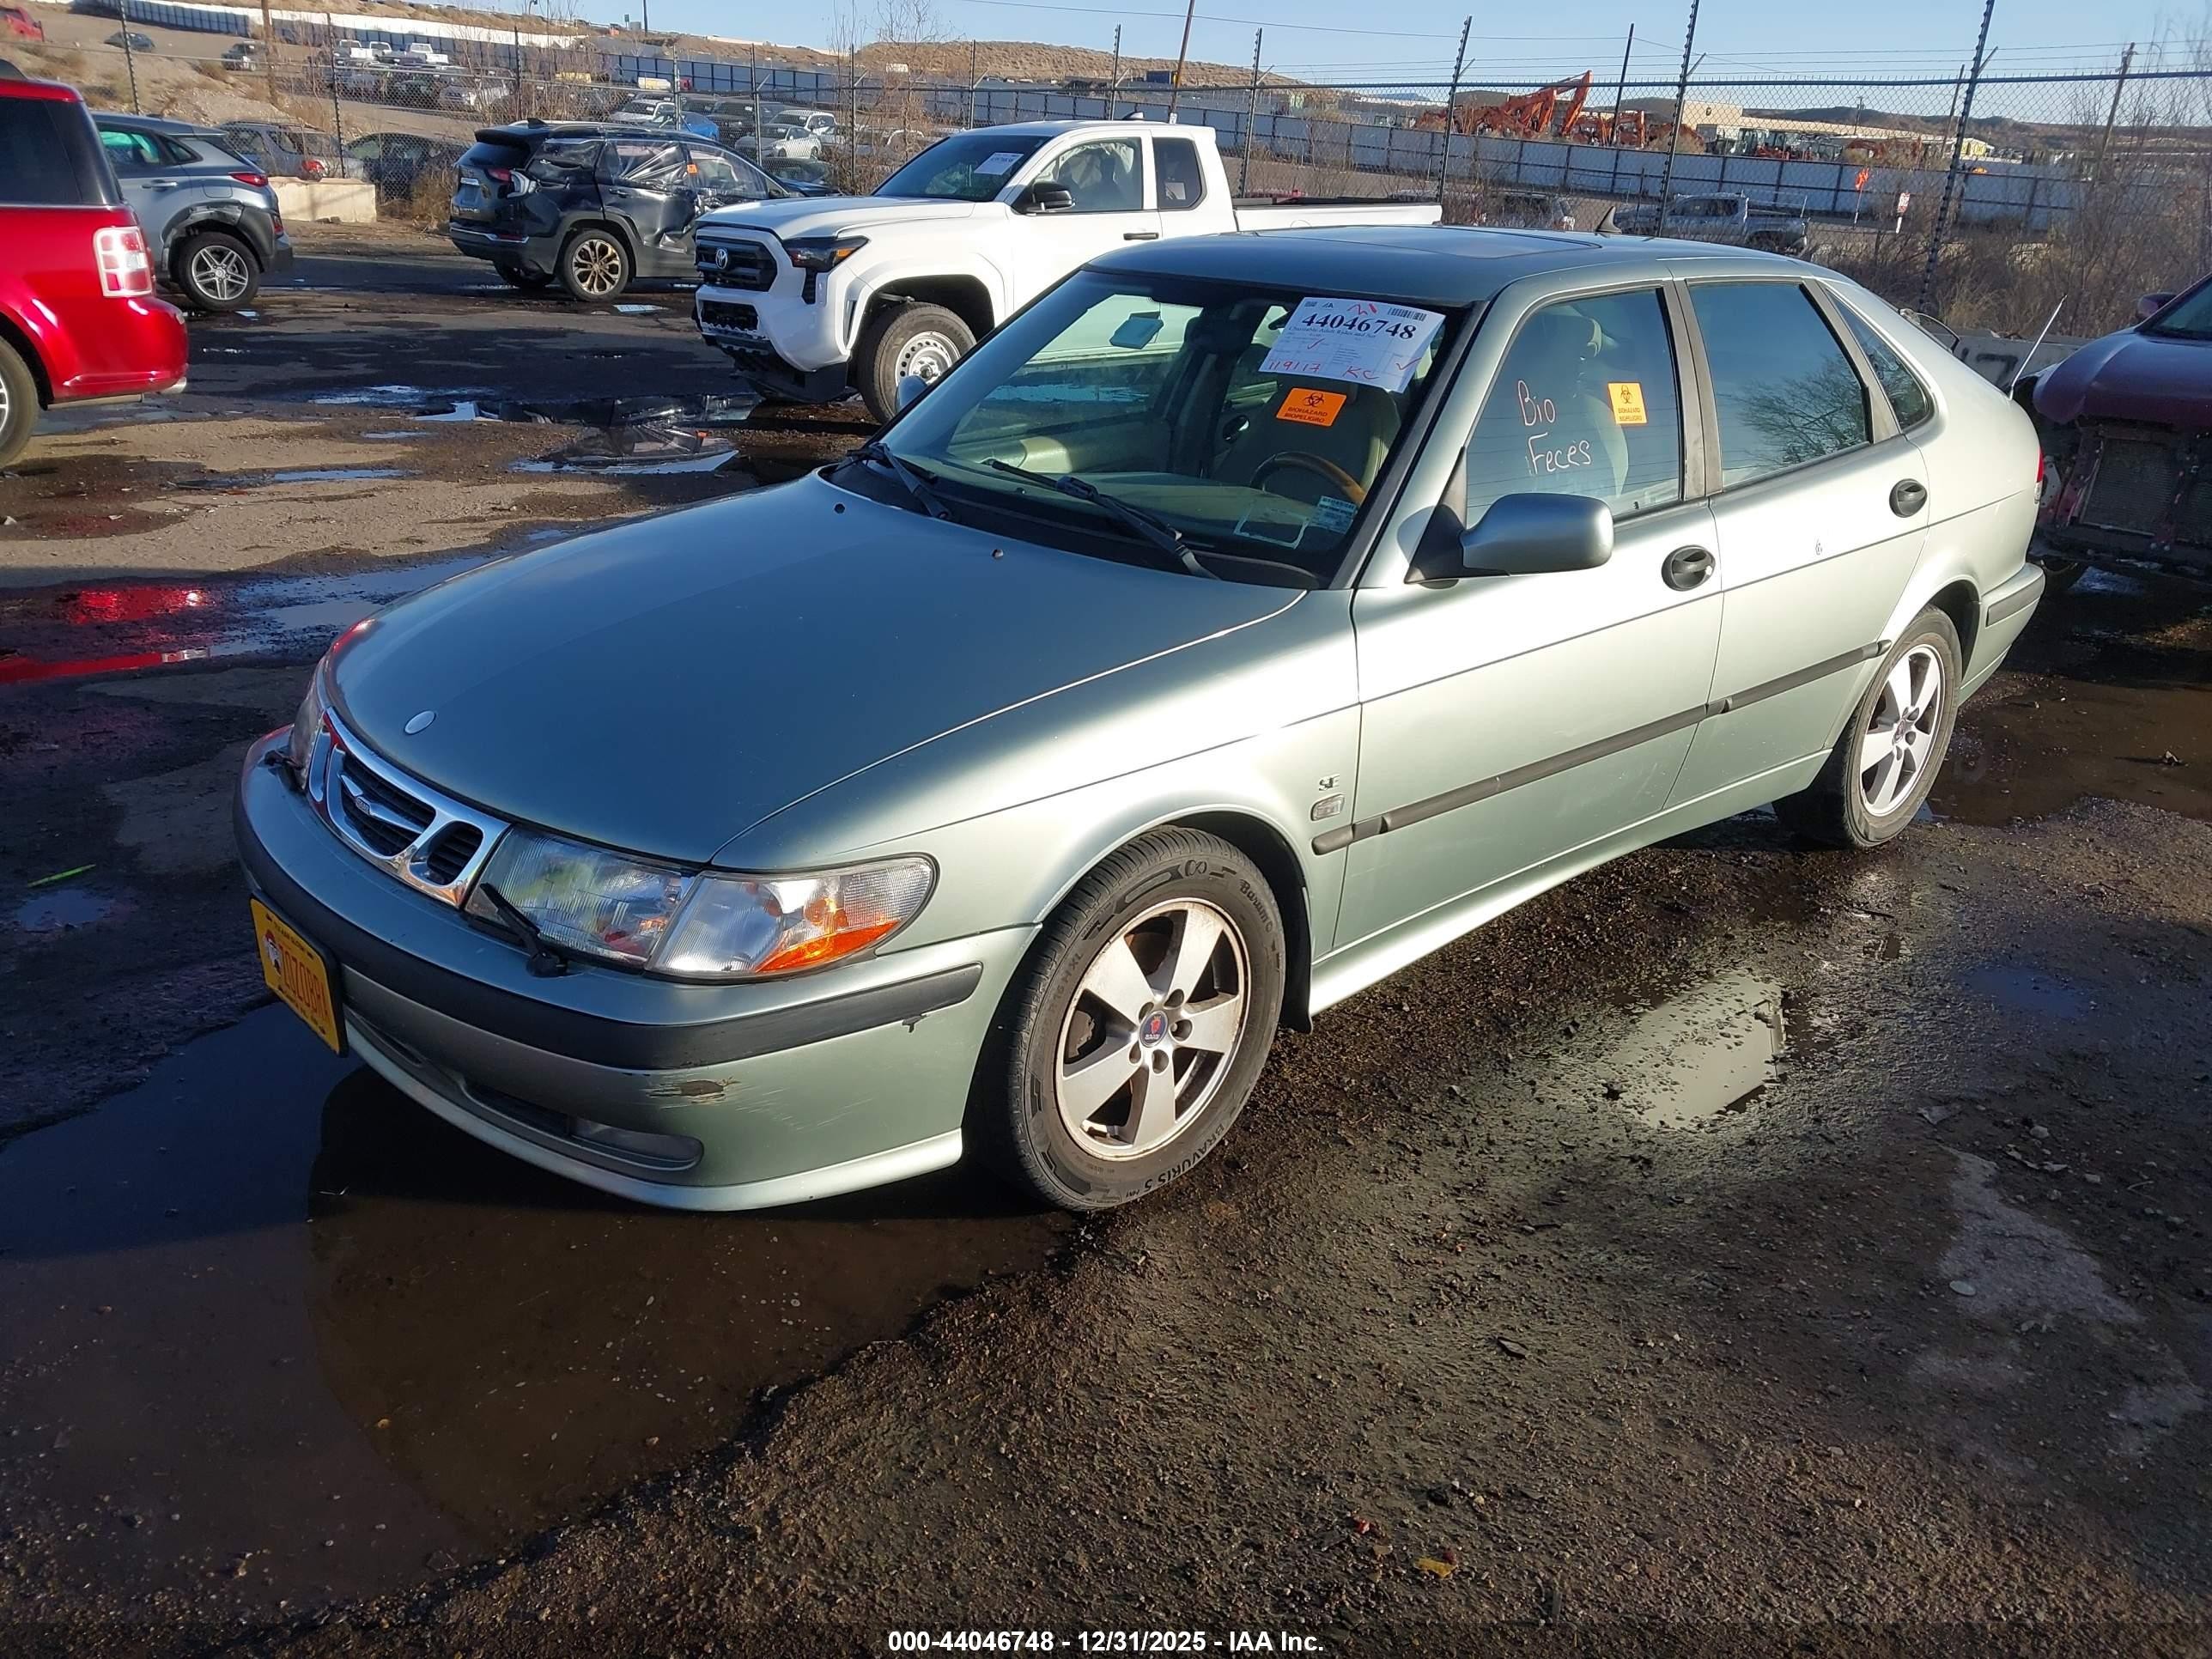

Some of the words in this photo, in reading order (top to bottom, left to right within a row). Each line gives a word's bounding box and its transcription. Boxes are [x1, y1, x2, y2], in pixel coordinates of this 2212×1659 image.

[1302, 313, 1417, 340] 44046748
[1284, 412, 1325, 423] BIOPELIGRO
[1288, 406, 1328, 417] BIOHAZARD
[1517, 380, 1556, 426] Bio
[1528, 432, 1592, 475] Feces
[1240, 878, 1268, 923] Barum
[1158, 1123, 1224, 1185] BRAVURIS
[1144, 1178, 1153, 1193] 5
